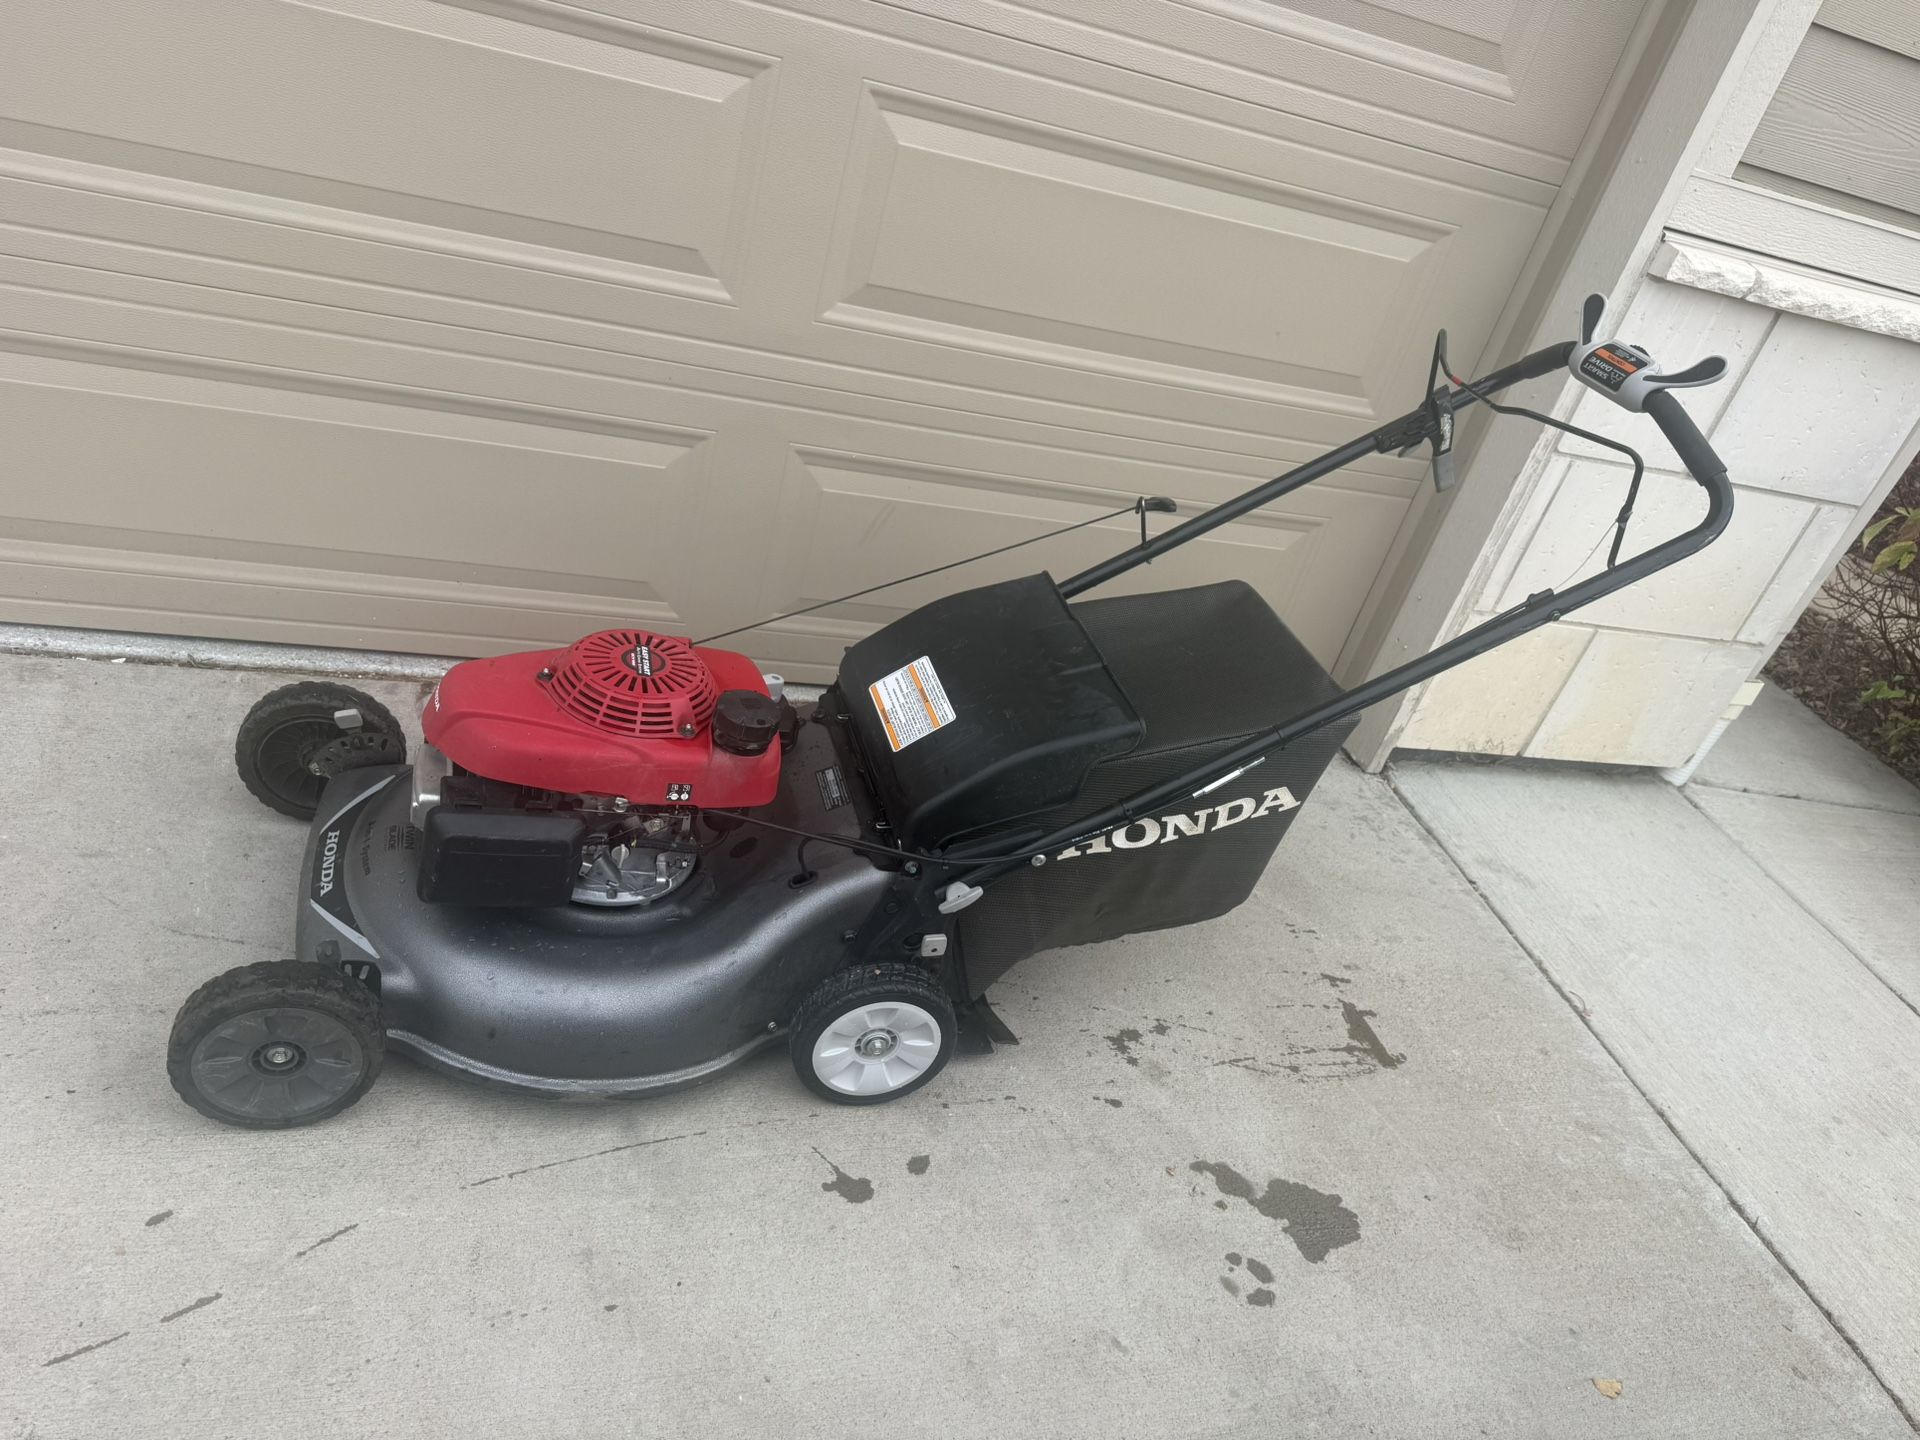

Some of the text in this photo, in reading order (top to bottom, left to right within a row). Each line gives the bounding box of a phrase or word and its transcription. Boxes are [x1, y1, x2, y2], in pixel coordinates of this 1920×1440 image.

[1584, 363, 1609, 379] SMART
[1588, 356, 1613, 372] DRIVE
[641, 646, 649, 659] EASY
[1057, 786, 1301, 861] HONDA
[319, 830, 341, 897] HONDA
